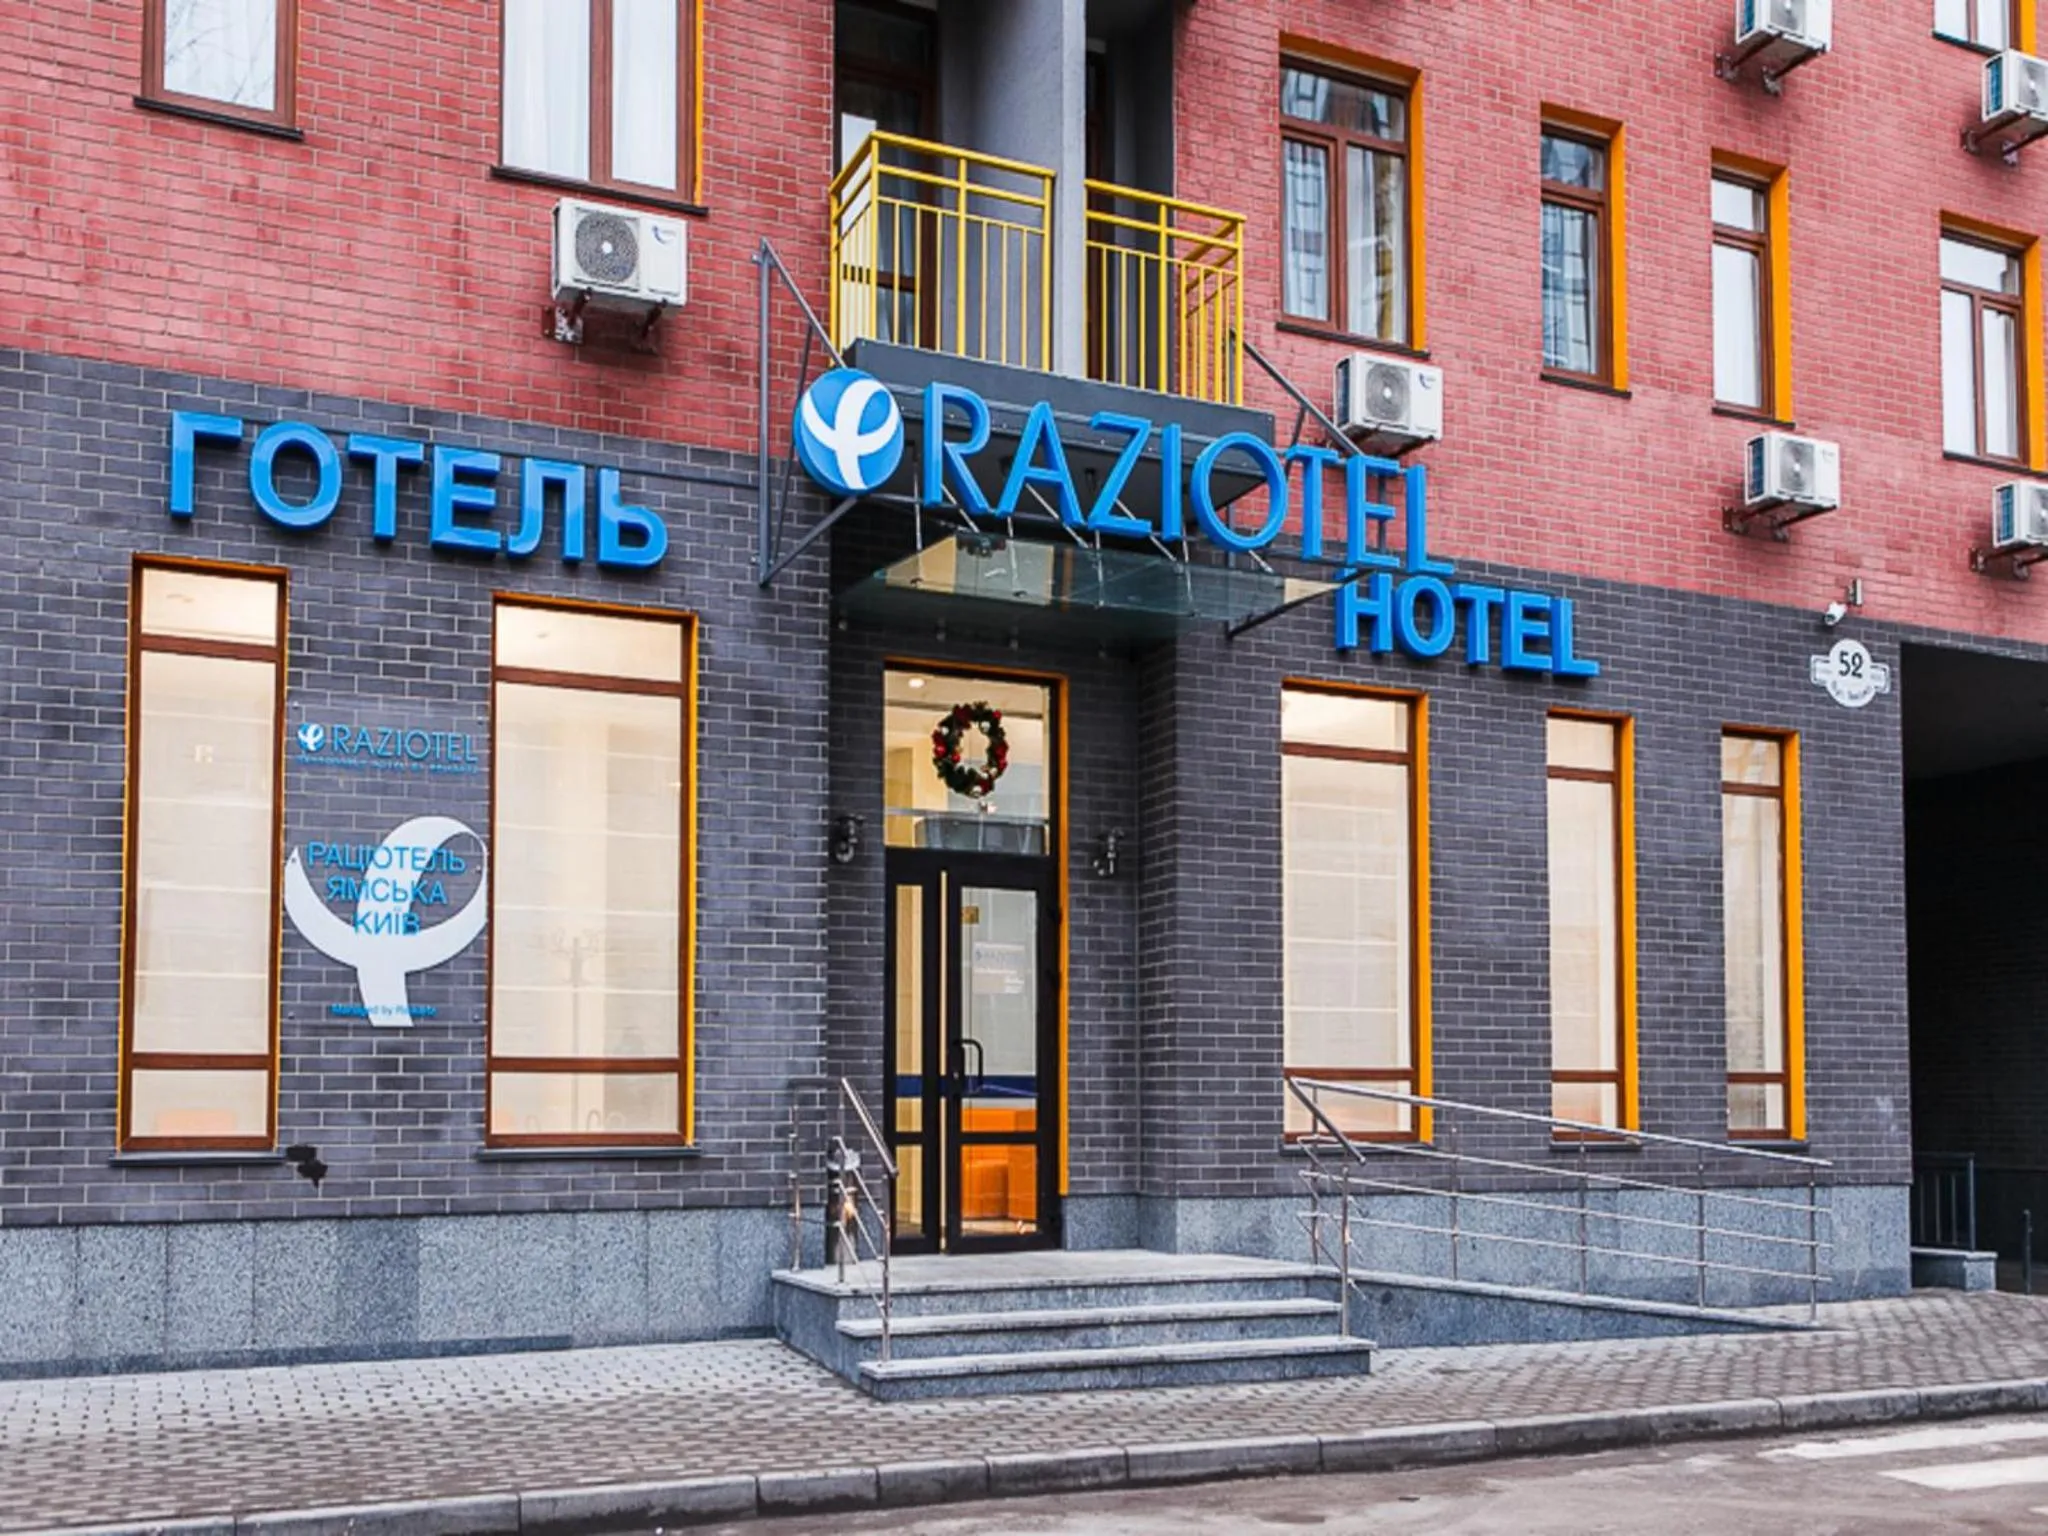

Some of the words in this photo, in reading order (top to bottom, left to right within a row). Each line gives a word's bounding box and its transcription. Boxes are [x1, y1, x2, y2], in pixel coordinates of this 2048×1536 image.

[169, 410, 669, 569] ГОТЕЛЬ
[923, 382, 1455, 576] RAZIOTEL
[1335, 567, 1600, 679] HOTEL
[1838, 650, 1864, 679] 52
[332, 723, 479, 764] RAZIOTEL
[306, 840, 467, 874] РАЦІОТЕЛЬ
[326, 875, 448, 906] ЯМСЬКА
[353, 905, 421, 936] КИЇВ
